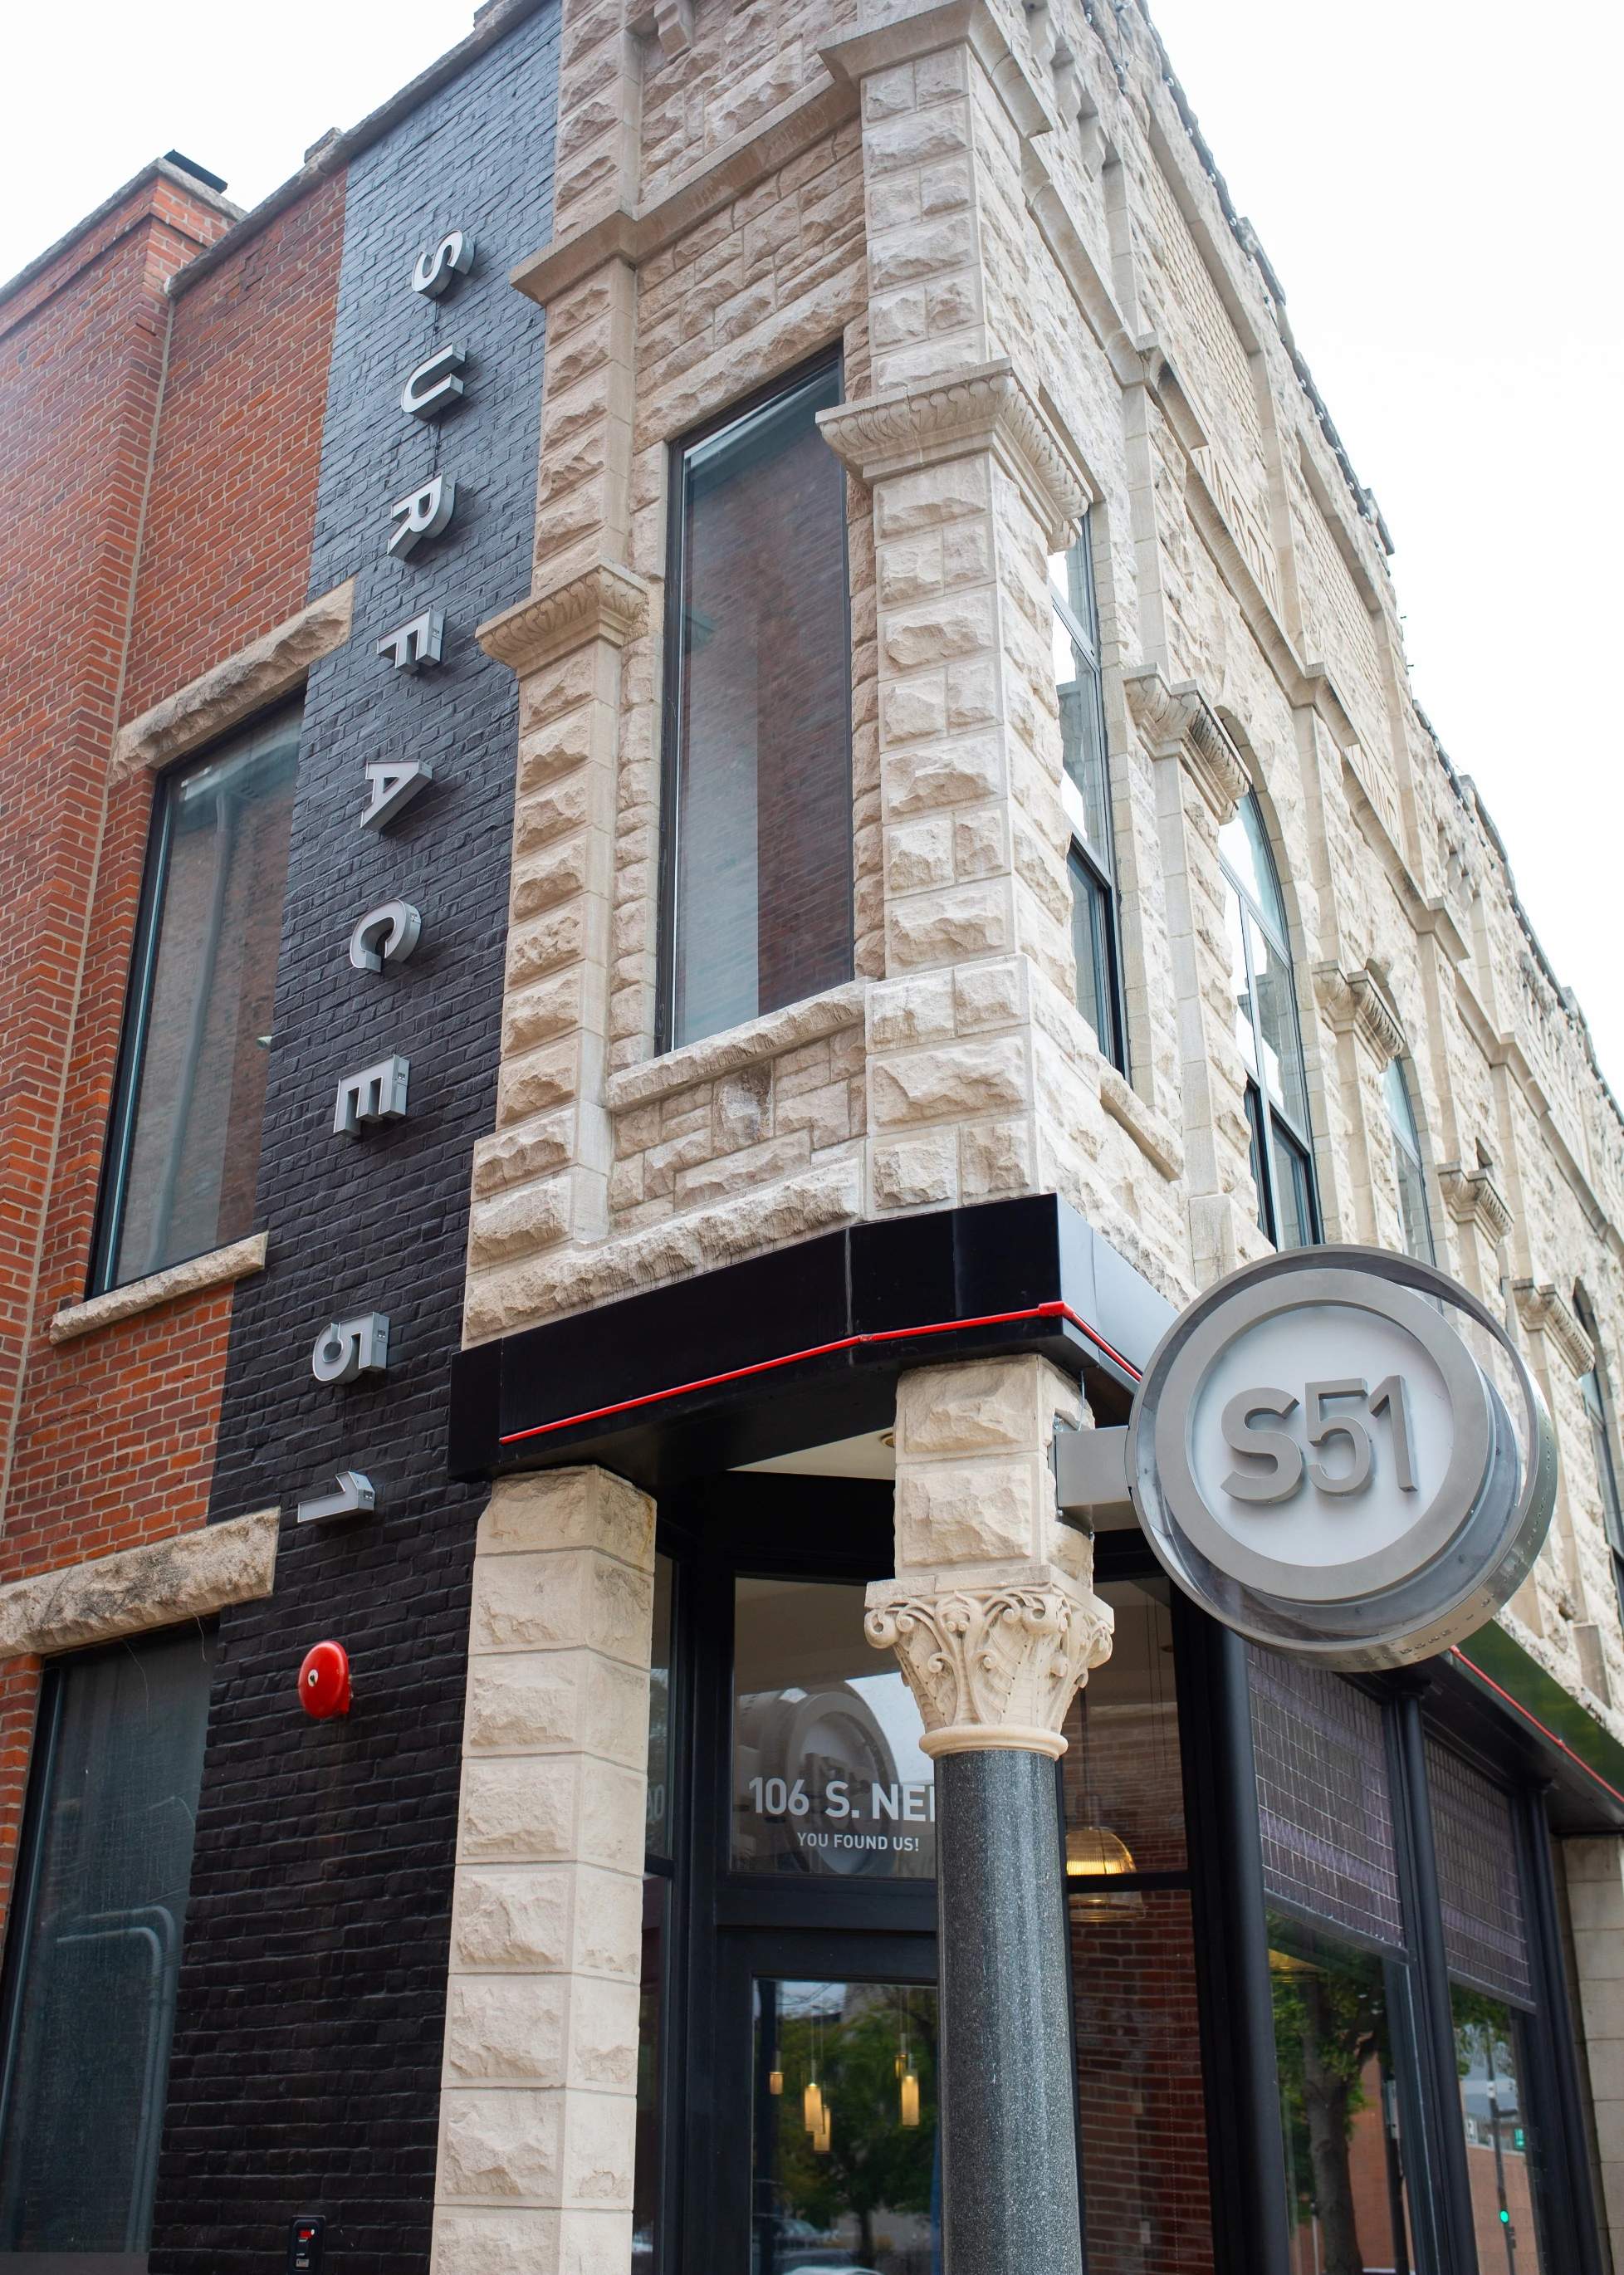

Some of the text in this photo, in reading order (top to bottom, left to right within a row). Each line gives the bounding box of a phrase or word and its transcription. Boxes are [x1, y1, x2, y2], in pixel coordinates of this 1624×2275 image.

[297, 229, 474, 1525] SURFACE 51
[1220, 1374, 1418, 1504] S51
[749, 1776, 810, 1816] 106
[824, 1780, 860, 1818] S.
[796, 1832, 920, 1852] YOU FOUND US!
